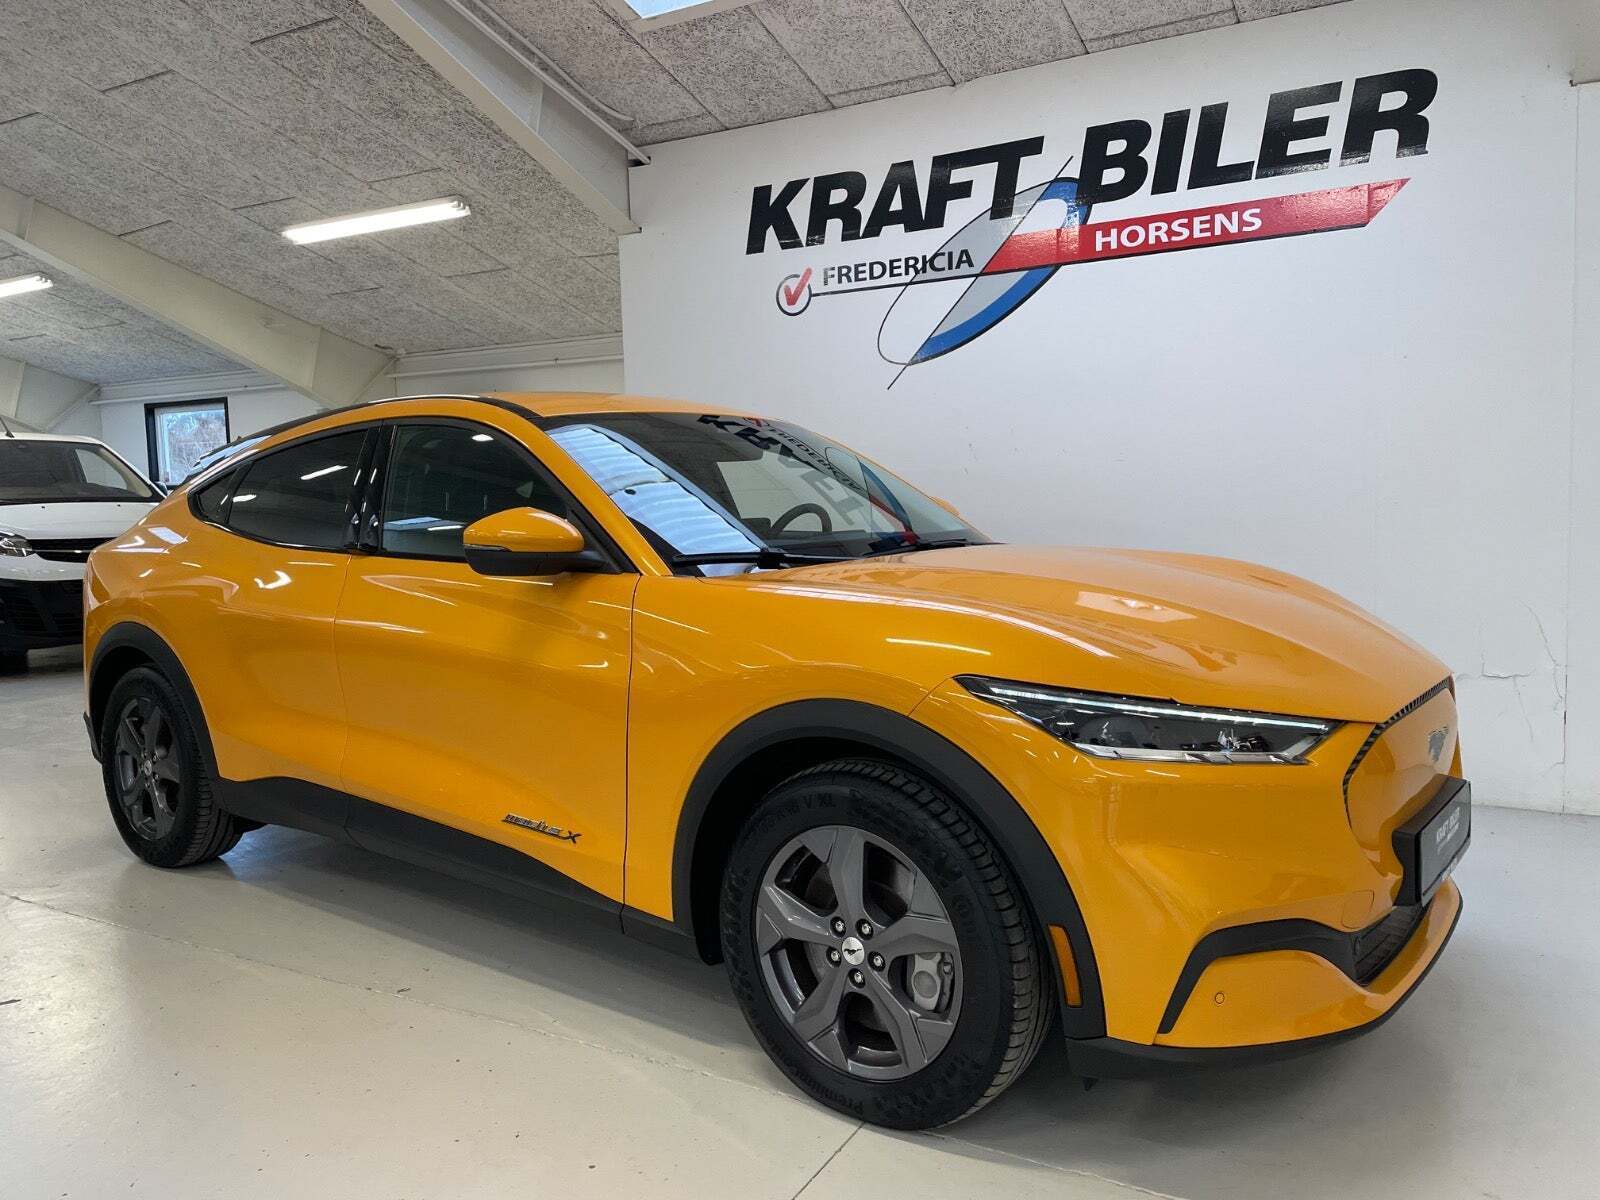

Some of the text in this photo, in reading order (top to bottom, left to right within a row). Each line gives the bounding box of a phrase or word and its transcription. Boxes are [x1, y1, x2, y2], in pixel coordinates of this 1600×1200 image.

[745, 68, 1439, 256] KRAFT BILER
[1095, 207, 1263, 252] HORSENS
[823, 248, 975, 286] FREDERICIA
